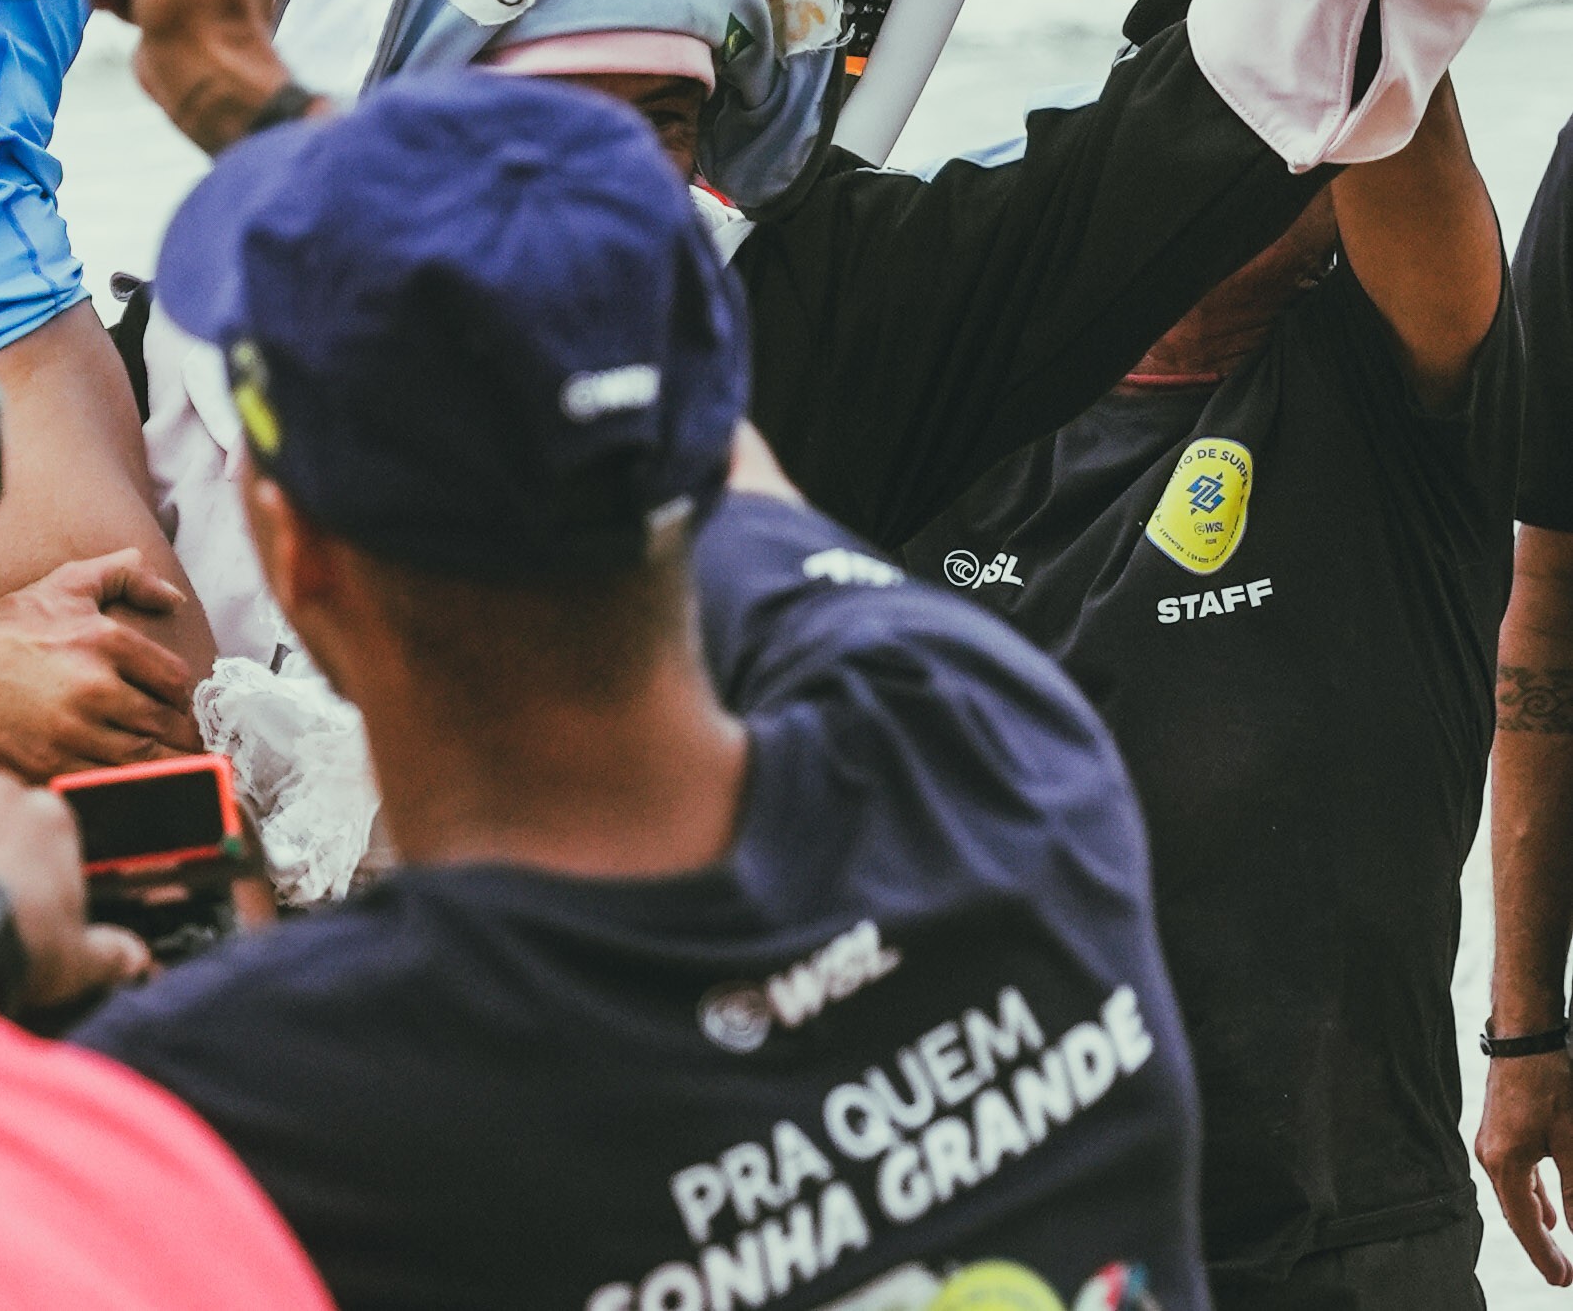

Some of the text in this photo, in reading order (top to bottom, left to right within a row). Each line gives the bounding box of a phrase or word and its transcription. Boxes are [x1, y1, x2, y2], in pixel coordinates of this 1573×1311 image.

[1197, 448, 1217, 460] DE
[1156, 577, 1274, 625] STAFF
[668, 984, 1048, 1245] PRA QUEM
[875, 981, 1156, 1225] GRANDE
